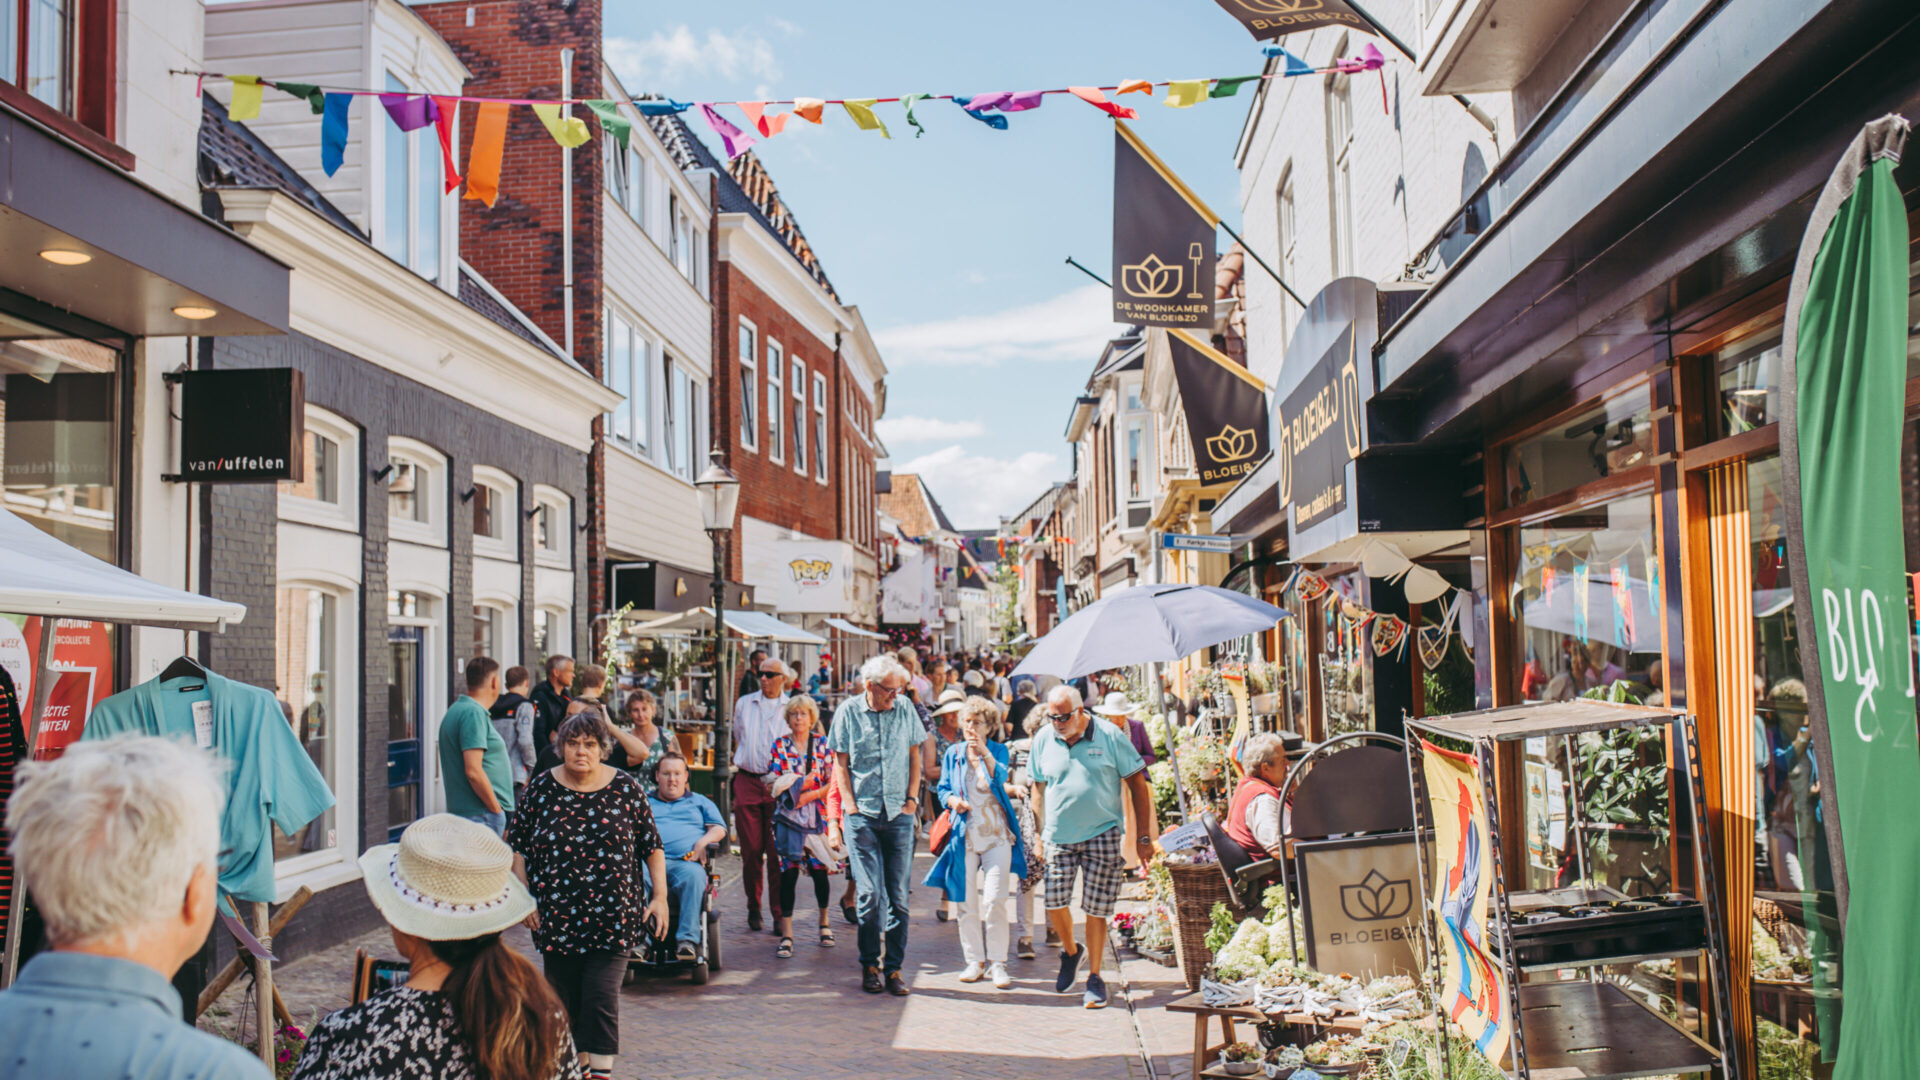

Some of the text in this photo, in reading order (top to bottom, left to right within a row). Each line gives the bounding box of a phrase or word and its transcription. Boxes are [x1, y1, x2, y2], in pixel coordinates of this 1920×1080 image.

[1251, 12, 1360, 30] BLOEI&ZO
[1116, 302, 1209, 314] DE WOONKAMER
[1126, 312, 1198, 322] VAN BLOEI&ZO
[1293, 378, 1338, 456] BLOEI&ZO
[189, 456, 284, 471] van/uffelen
[789, 559, 832, 581] POP!
[55, 635, 91, 645] ERCOLLECTIE
[42, 705, 71, 717] ECTIE
